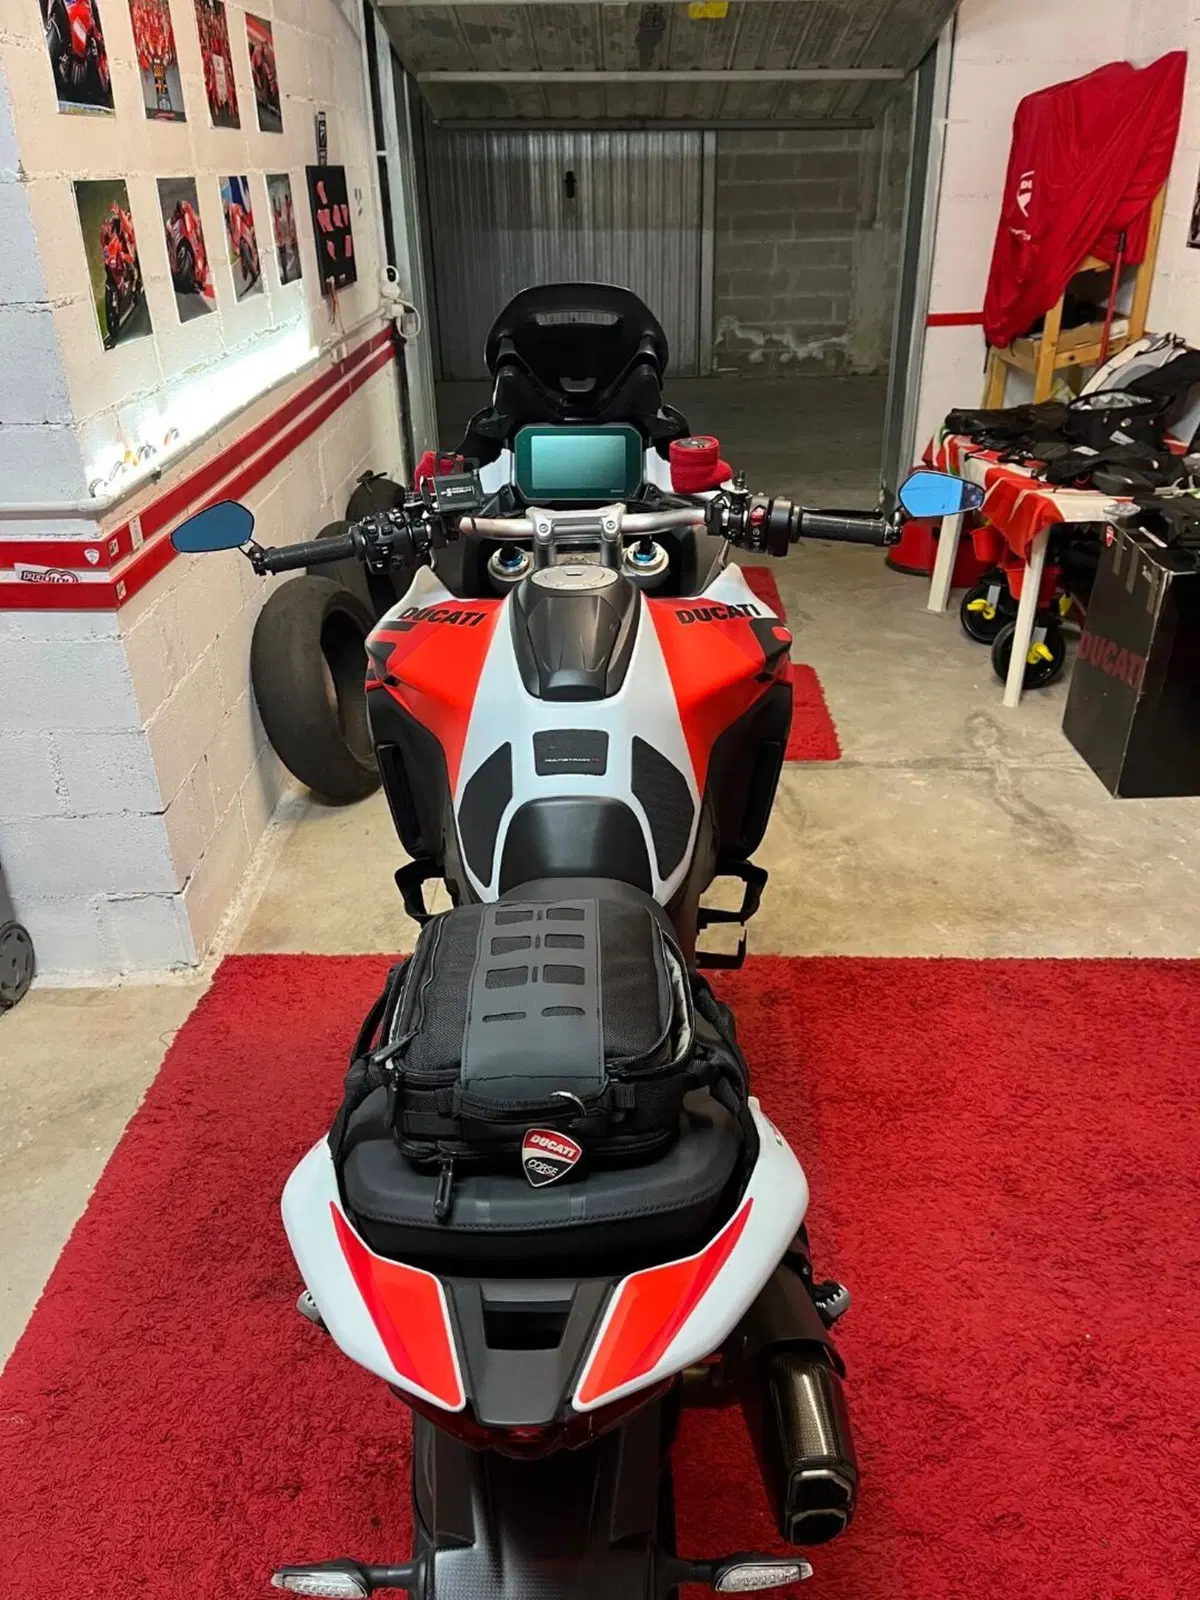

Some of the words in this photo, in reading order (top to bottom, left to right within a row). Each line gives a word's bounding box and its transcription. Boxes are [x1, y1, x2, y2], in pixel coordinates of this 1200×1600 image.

[397, 607, 487, 626] DUCATI
[675, 604, 761, 624] DUCATI
[1077, 631, 1147, 690] DUCATI
[530, 1134, 577, 1158] DUCATI
[528, 1159, 559, 1176] CORSE
